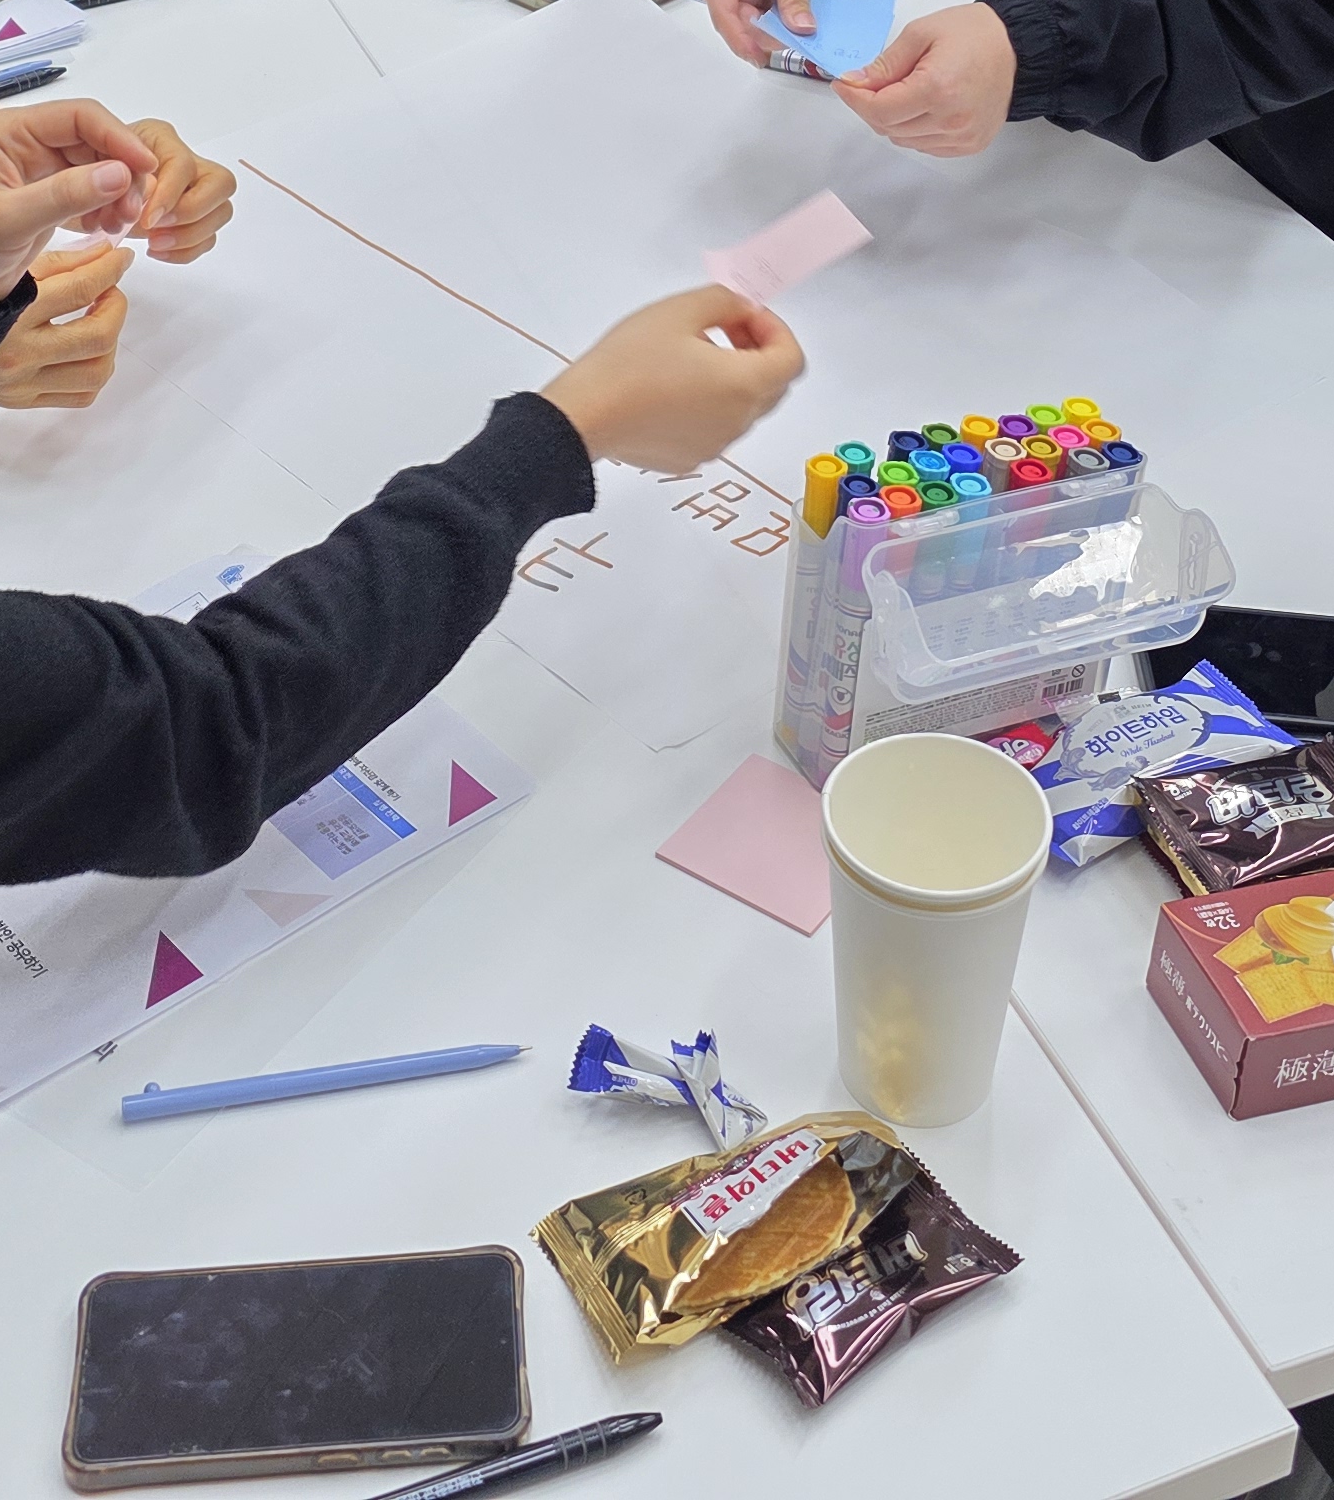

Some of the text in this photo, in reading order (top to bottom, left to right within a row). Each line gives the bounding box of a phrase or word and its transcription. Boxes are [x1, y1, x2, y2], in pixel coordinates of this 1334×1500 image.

[1084, 705, 1187, 758] 화이트하임
[1206, 773, 1334, 825] 버터링
[1204, 912, 1242, 930] 32枚
[5, 936, 49, 980] 공유하기
[1157, 948, 1230, 1066] 極薄 ポテクリスピー
[701, 1137, 810, 1224] 버터와플
